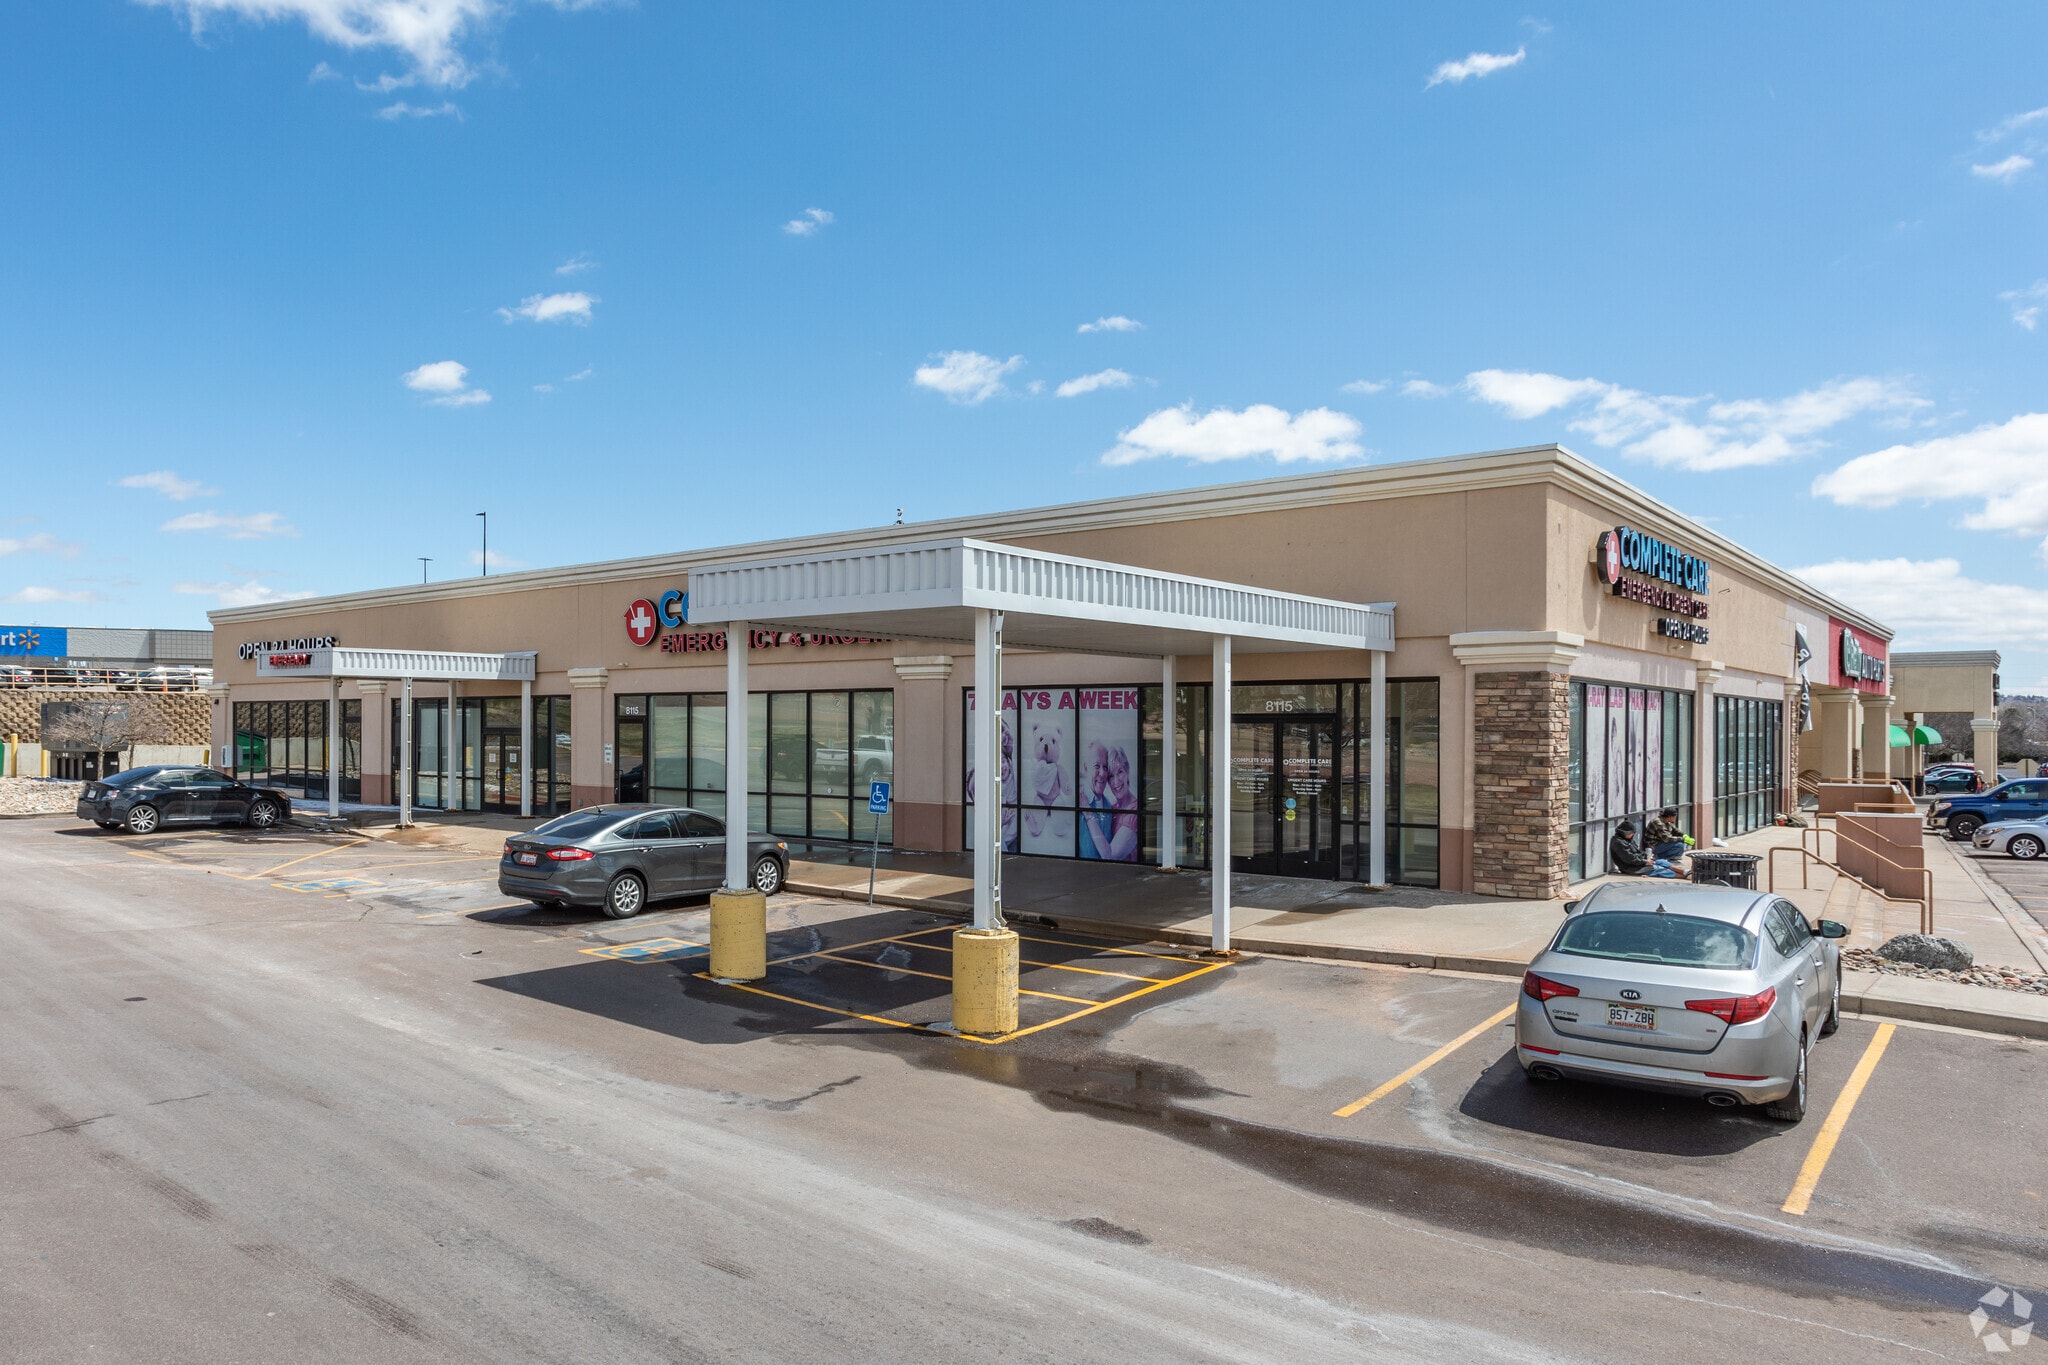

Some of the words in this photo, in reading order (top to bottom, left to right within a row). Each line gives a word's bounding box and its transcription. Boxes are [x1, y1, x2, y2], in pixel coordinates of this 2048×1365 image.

[1621, 525, 1682, 585] COMPLETE
[1684, 554, 1710, 595] CARE
[1666, 618, 1682, 639] OPEN
[1683, 622, 1691, 640] 24
[661, 629, 779, 652] EMERGCY
[788, 631, 802, 647] &
[1001, 692, 1051, 710] AYS
[1058, 691, 1075, 710] A
[1079, 691, 1138, 710] WEEK
[1265, 700, 1293, 712] 8115
[1608, 687, 1624, 708] LAB
[625, 706, 640, 715] 8115
